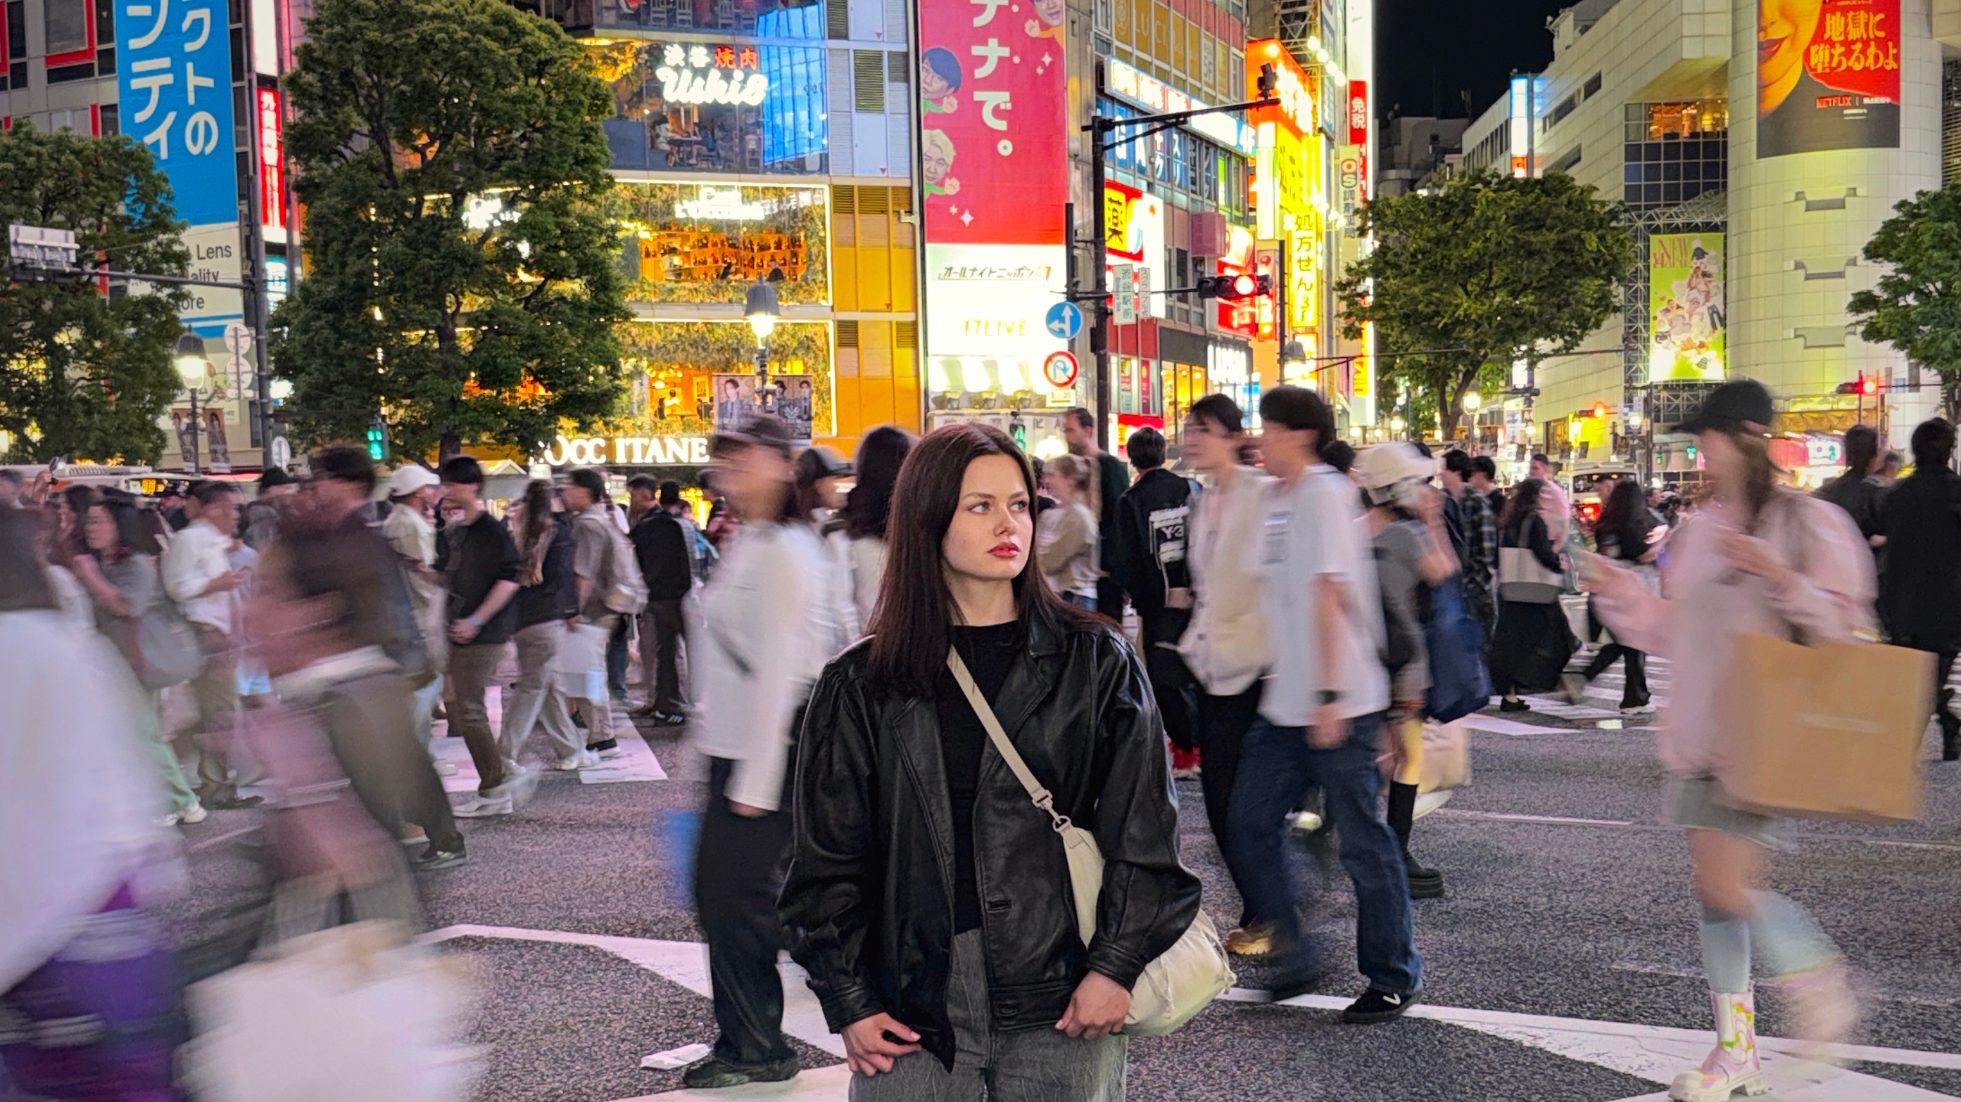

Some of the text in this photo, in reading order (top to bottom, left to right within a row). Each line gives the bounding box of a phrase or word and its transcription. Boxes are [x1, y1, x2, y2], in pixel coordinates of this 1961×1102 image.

[1823, 10, 1887, 41] 地獄に
[1809, 41, 1898, 73] 堕ちるわよ
[1351, 97, 1365, 129] 免税
[1108, 196, 1123, 244] 薬
[196, 244, 232, 261] Lens
[963, 319, 1027, 337] 17LIVE
